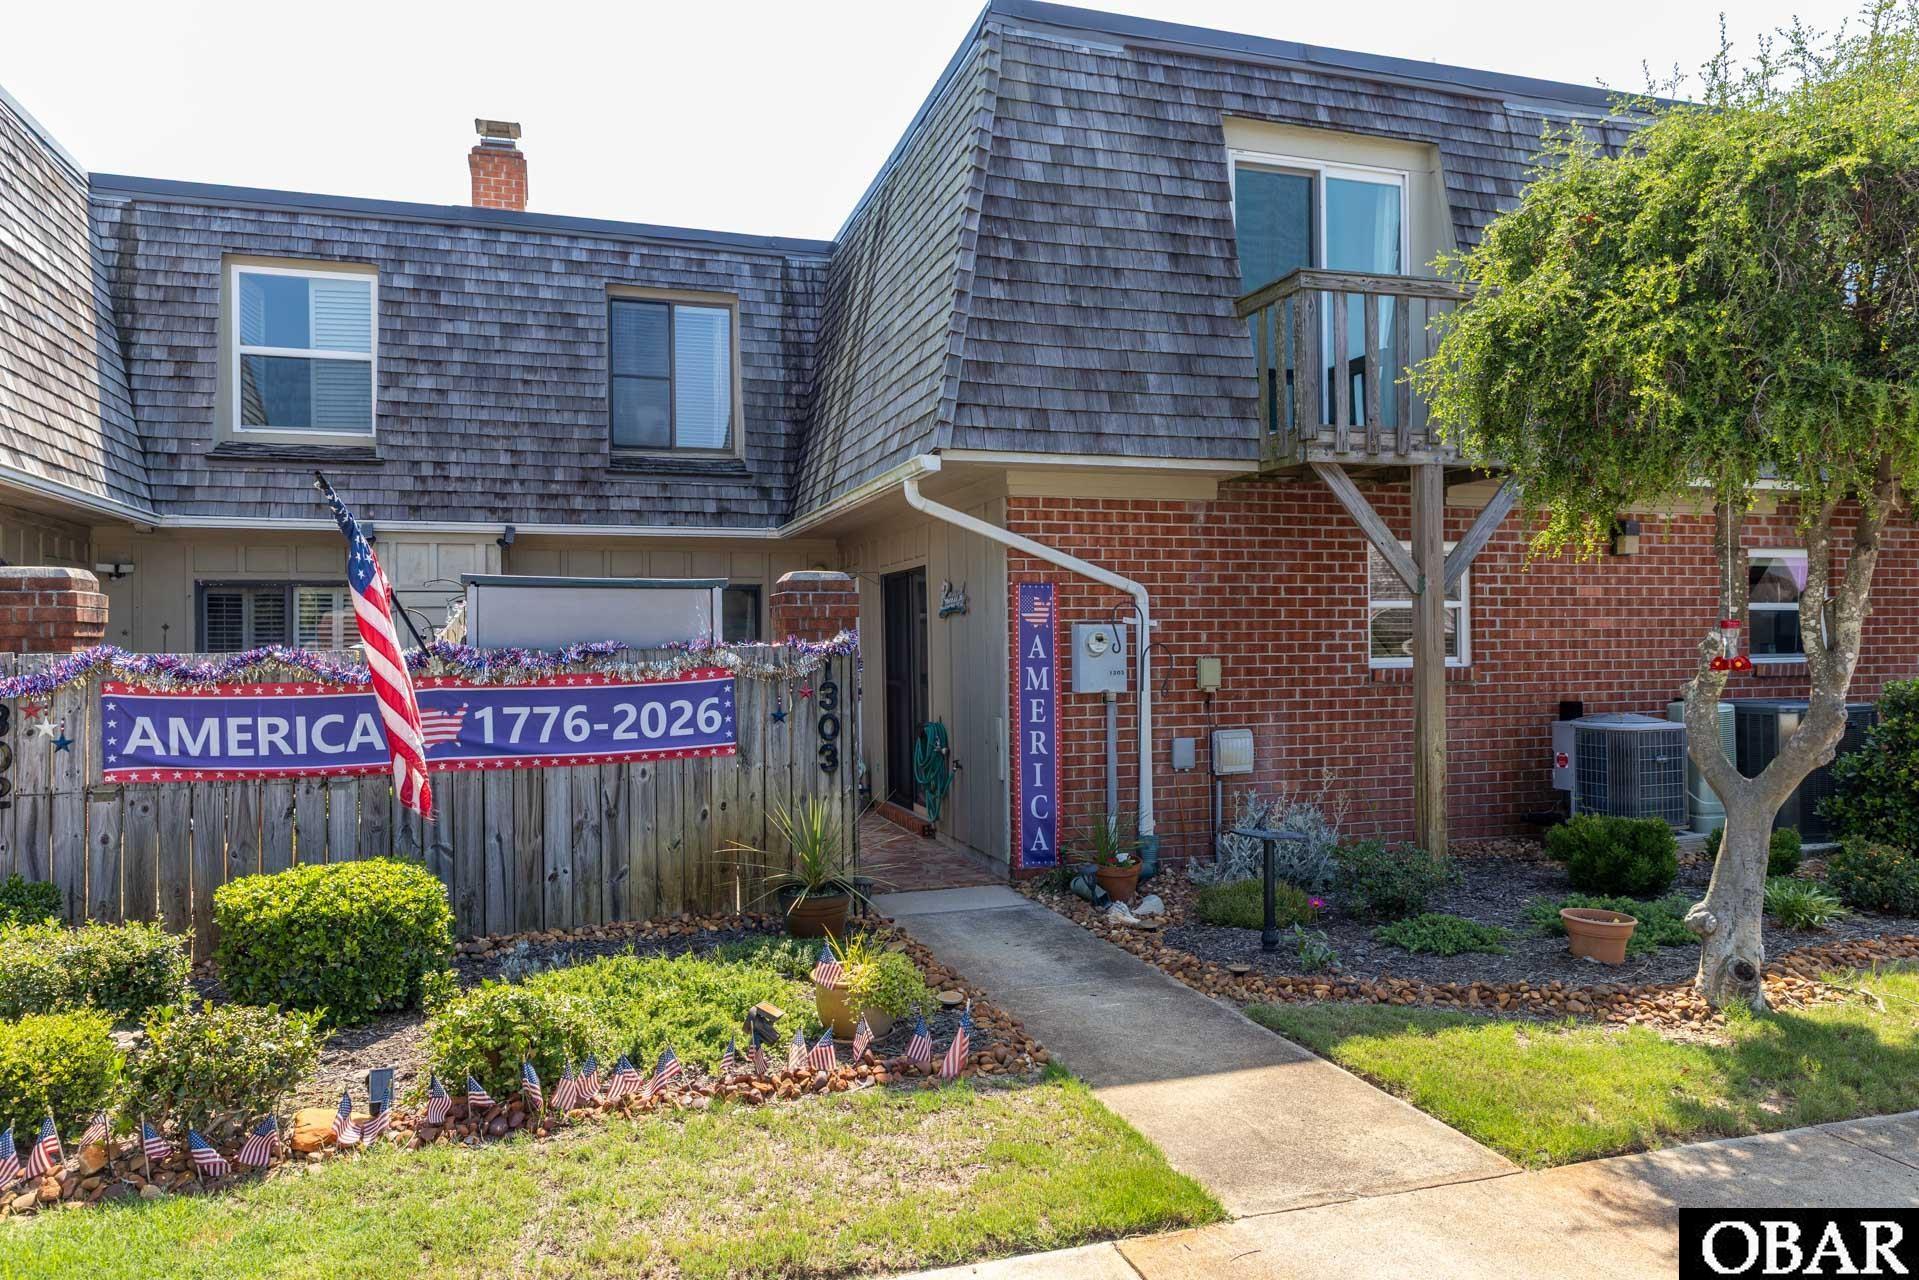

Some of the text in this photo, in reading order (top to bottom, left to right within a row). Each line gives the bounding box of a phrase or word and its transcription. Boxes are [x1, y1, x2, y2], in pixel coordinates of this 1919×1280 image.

[122, 713, 386, 757] AMERICA
[474, 696, 723, 745] 1776-2026
[1025, 634, 1049, 851] AMERICA
